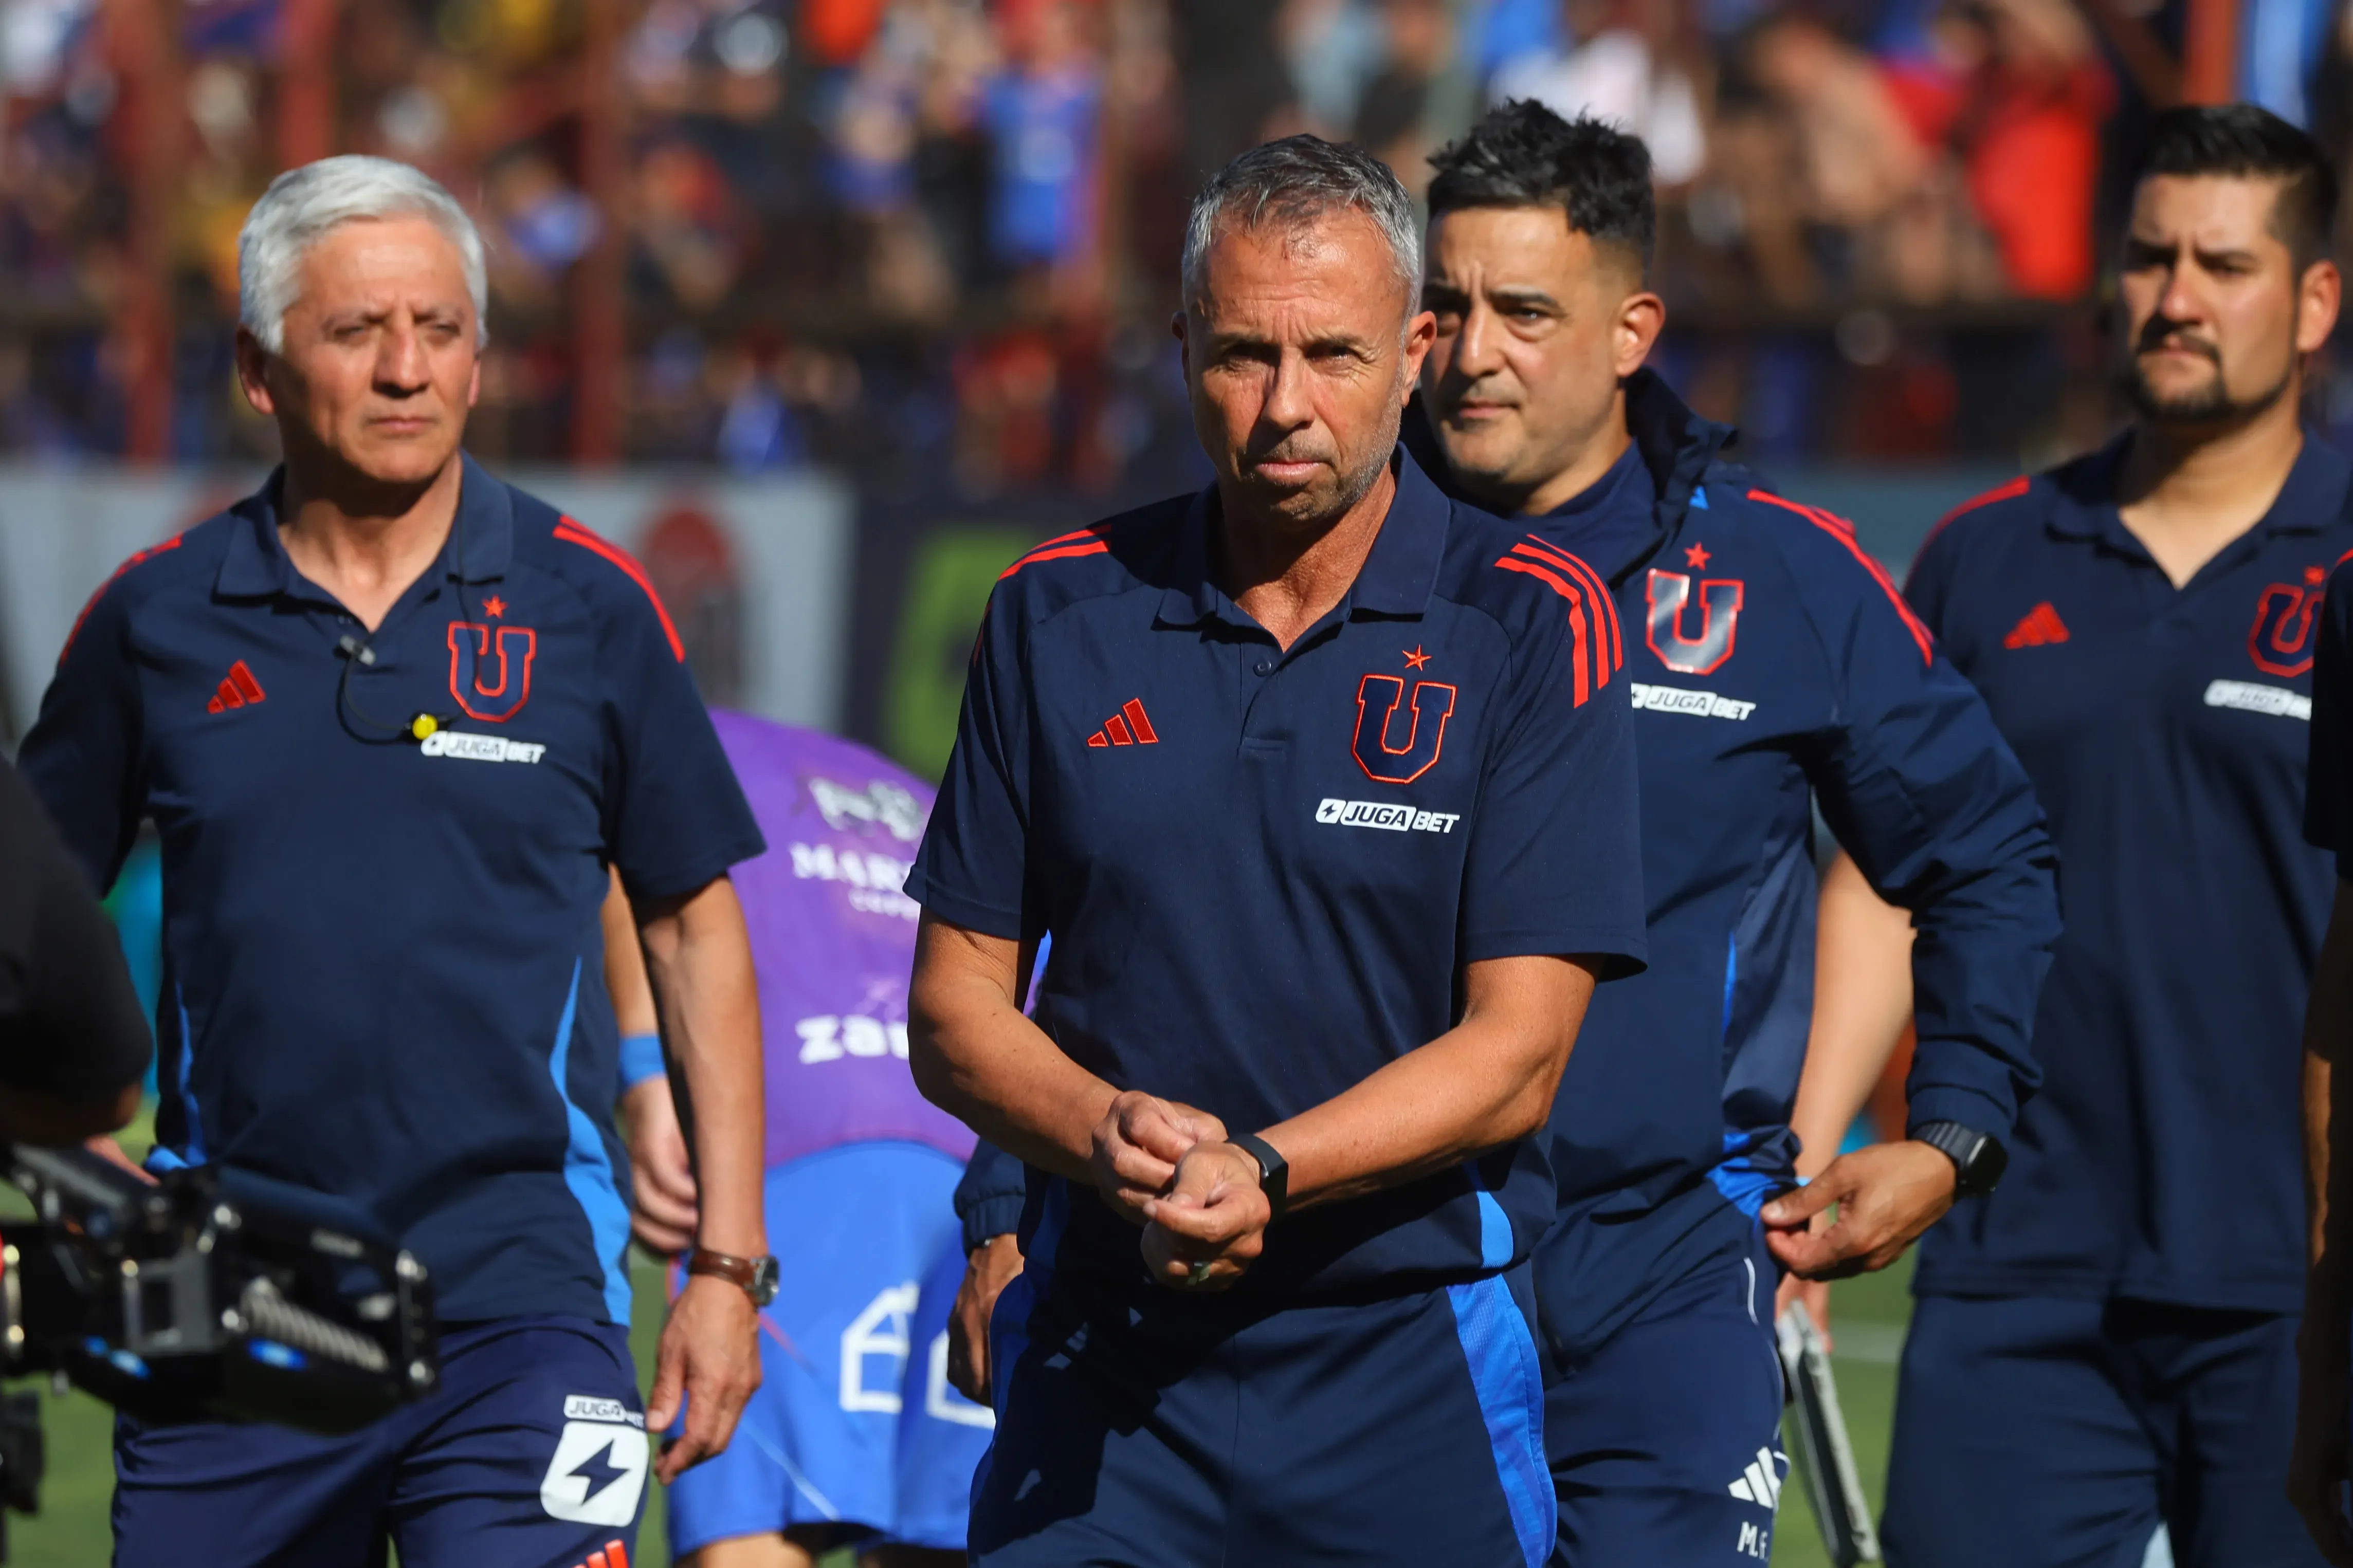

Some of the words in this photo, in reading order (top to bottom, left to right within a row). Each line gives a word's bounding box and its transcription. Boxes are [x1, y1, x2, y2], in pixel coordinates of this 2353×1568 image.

[447, 621, 537, 723] U
[1645, 568, 1744, 676] U
[1351, 673, 1457, 784] U
